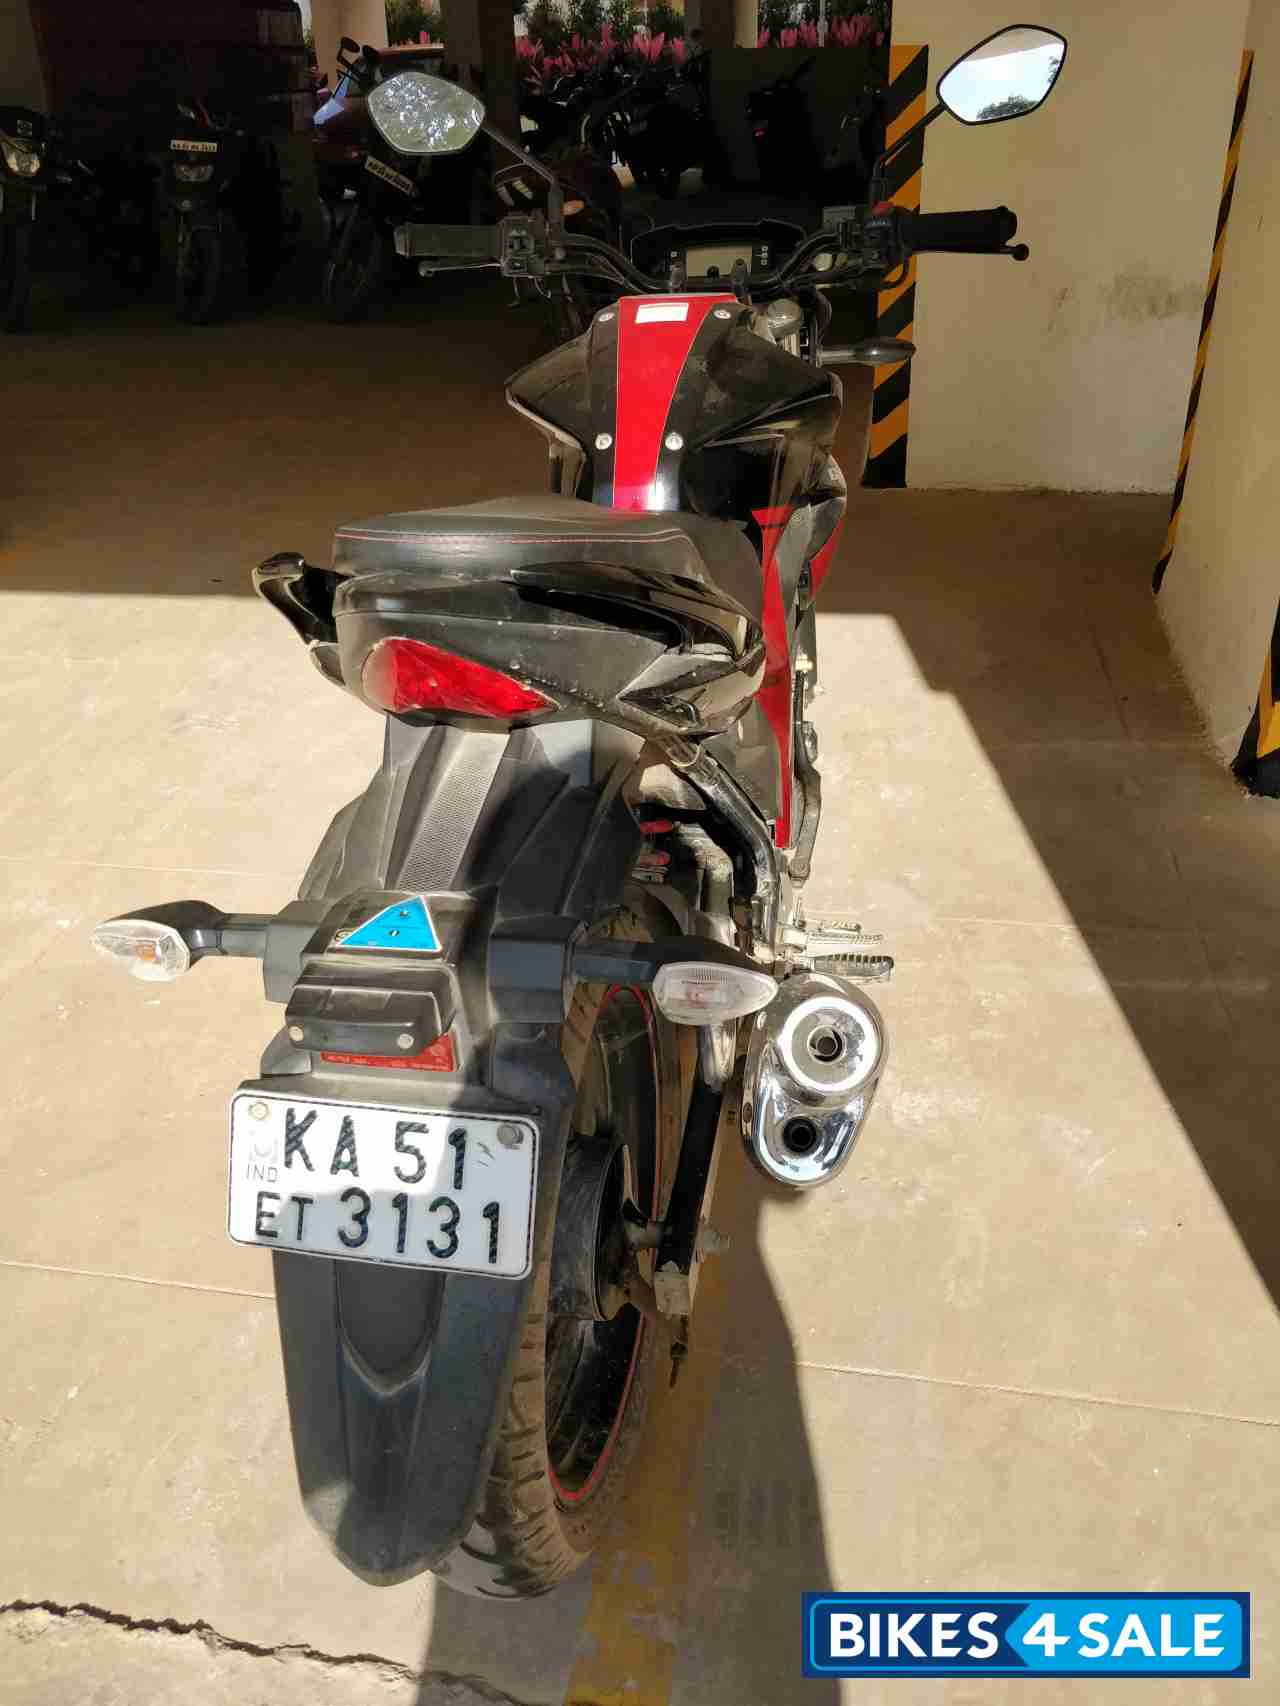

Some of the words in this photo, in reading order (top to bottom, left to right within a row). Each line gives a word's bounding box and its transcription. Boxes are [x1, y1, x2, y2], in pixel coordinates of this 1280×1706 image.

[246, 1163, 278, 1183] IND
[284, 1107, 360, 1178] KA
[393, 1120, 468, 1190] 51
[255, 1190, 314, 1241] ET
[337, 1186, 501, 1264] 3131
